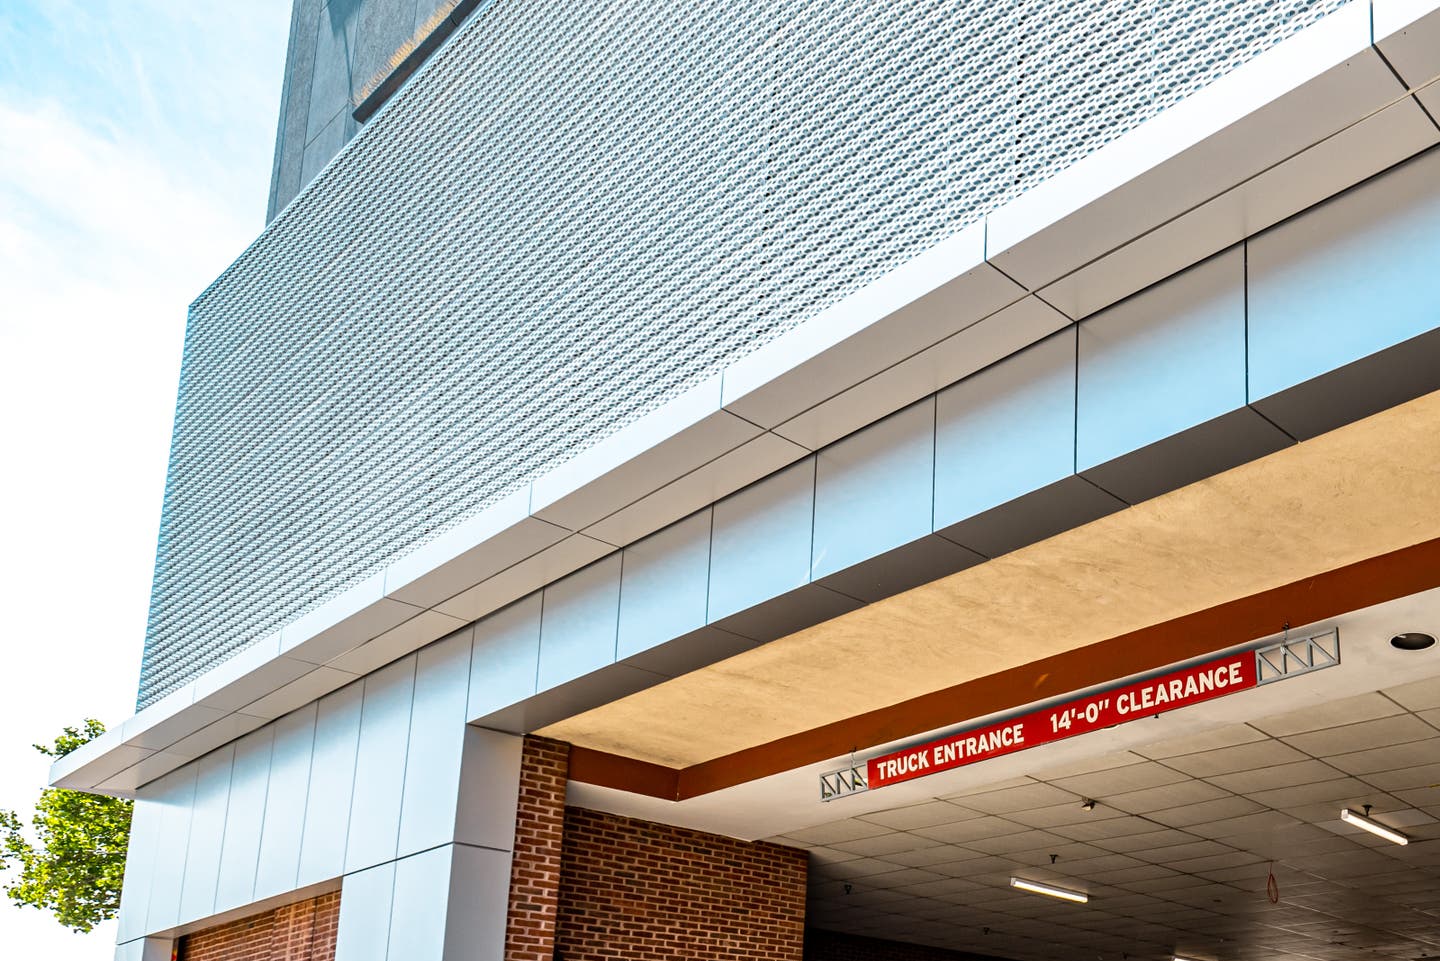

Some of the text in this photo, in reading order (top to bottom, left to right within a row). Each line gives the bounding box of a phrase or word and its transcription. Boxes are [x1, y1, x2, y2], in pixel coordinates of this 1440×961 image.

[877, 750, 929, 780] TRUCK
[934, 723, 1025, 766] ENTRANCE
[1116, 661, 1243, 715] CLEARANCE
